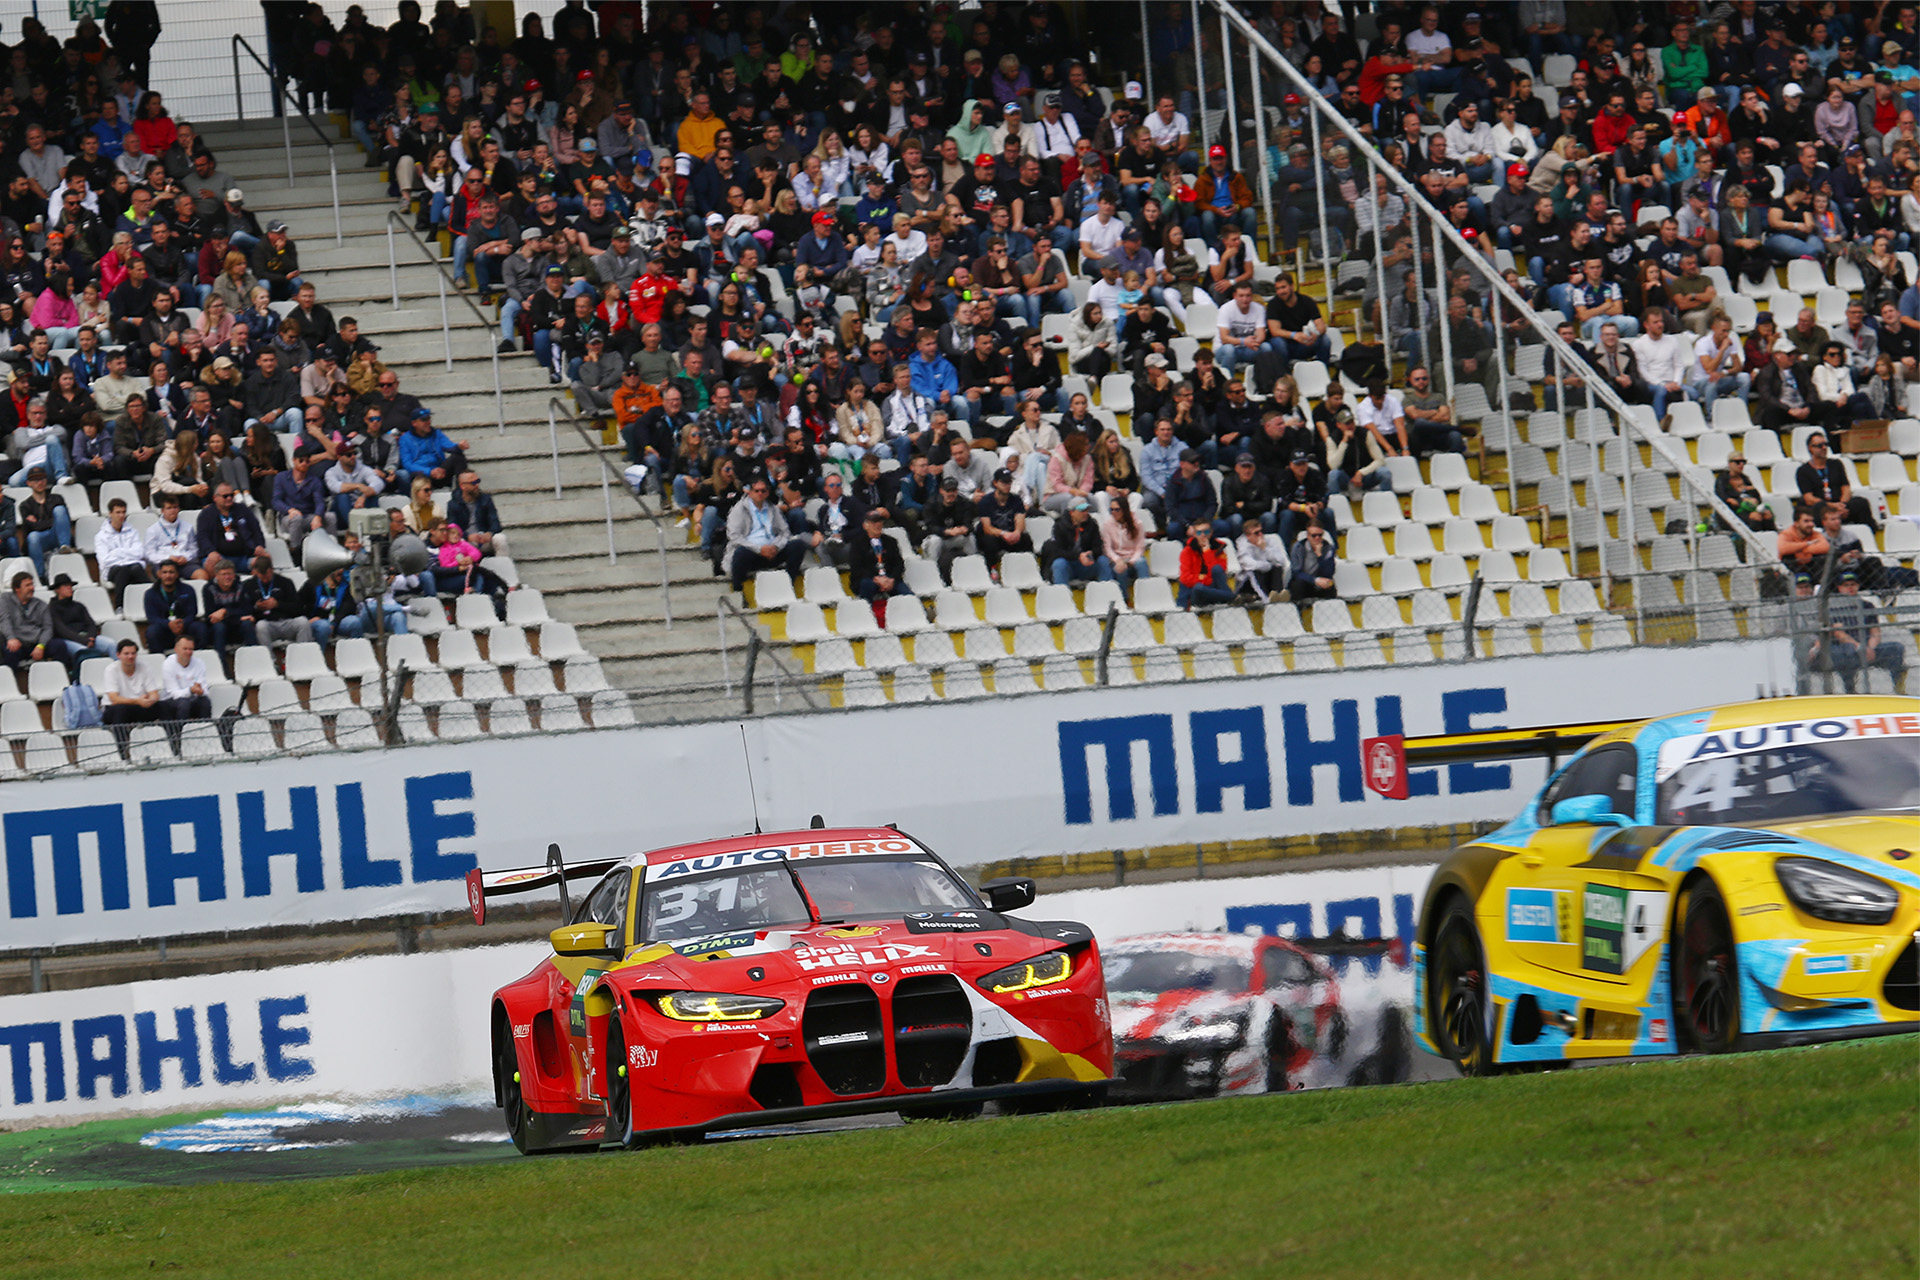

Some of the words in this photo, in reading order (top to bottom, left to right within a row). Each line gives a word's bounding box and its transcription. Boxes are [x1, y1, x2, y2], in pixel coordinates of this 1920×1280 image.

[3, 771, 478, 918] MAHLE
[657, 841, 911, 878] AUTOHERO
[655, 877, 739, 927] 31
[918, 921, 980, 929] Motorsport
[682, 938, 731, 953] DTM
[794, 943, 856, 959] Shell
[797, 943, 942, 971] HELIX
[812, 973, 858, 985] MAHLE
[900, 964, 947, 974] MAHLE
[0, 994, 316, 1106] MAHLE
